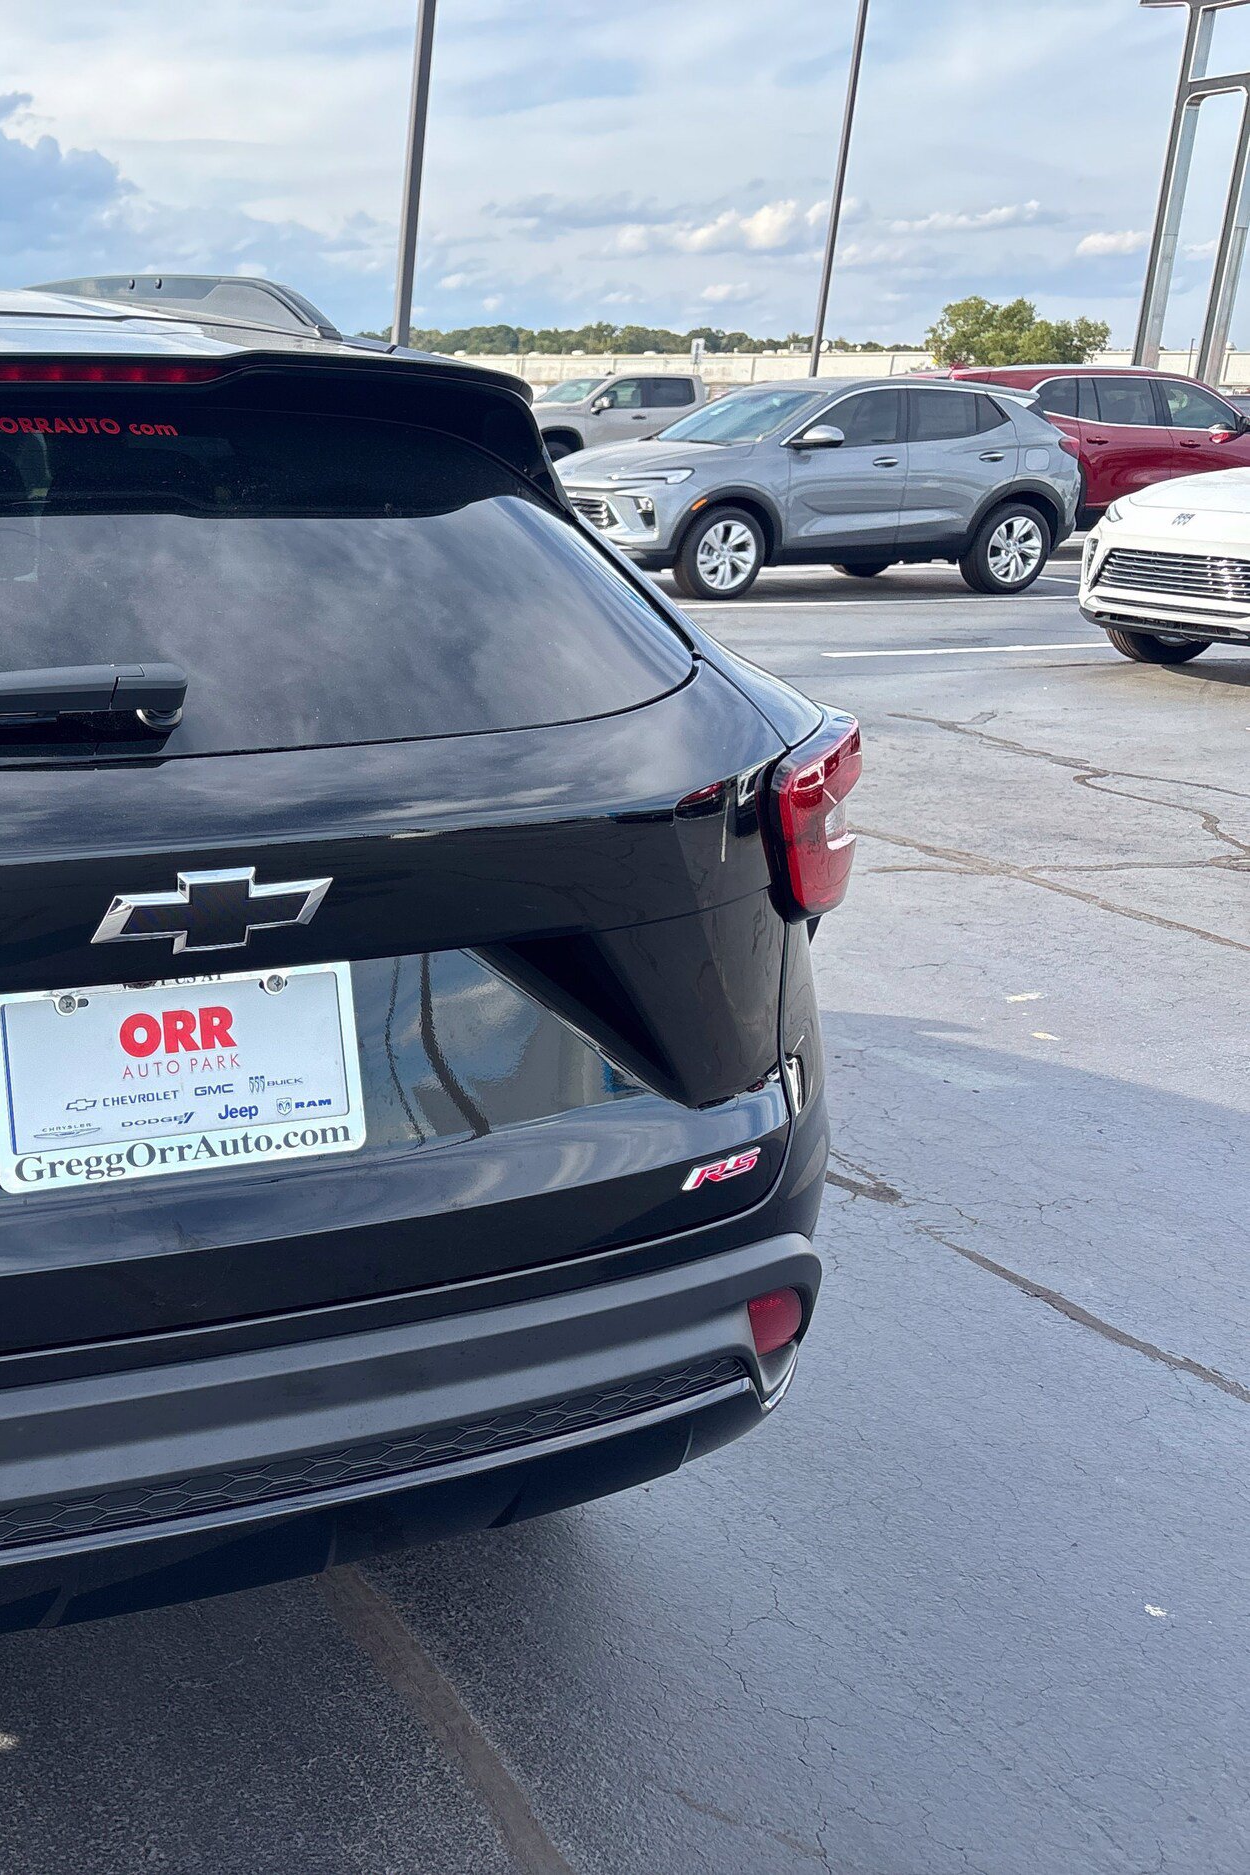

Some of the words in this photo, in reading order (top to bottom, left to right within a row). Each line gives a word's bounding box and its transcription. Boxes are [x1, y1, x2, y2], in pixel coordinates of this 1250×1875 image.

[119, 1006, 237, 1058] ORR
[123, 1060, 180, 1080] AUTO
[190, 1053, 241, 1073] PARK
[194, 1083, 234, 1097] GMC
[266, 1077, 303, 1087] BUICK
[102, 1090, 179, 1107] CHEVROLET
[294, 1098, 332, 1109] RAM
[218, 1104, 259, 1120] Jeep
[41, 1122, 92, 1133] CHRYSLER
[121, 1114, 184, 1128] DODGE
[15, 1125, 351, 1183] GreggOrrAuto.com
[680, 1146, 761, 1191] RS
